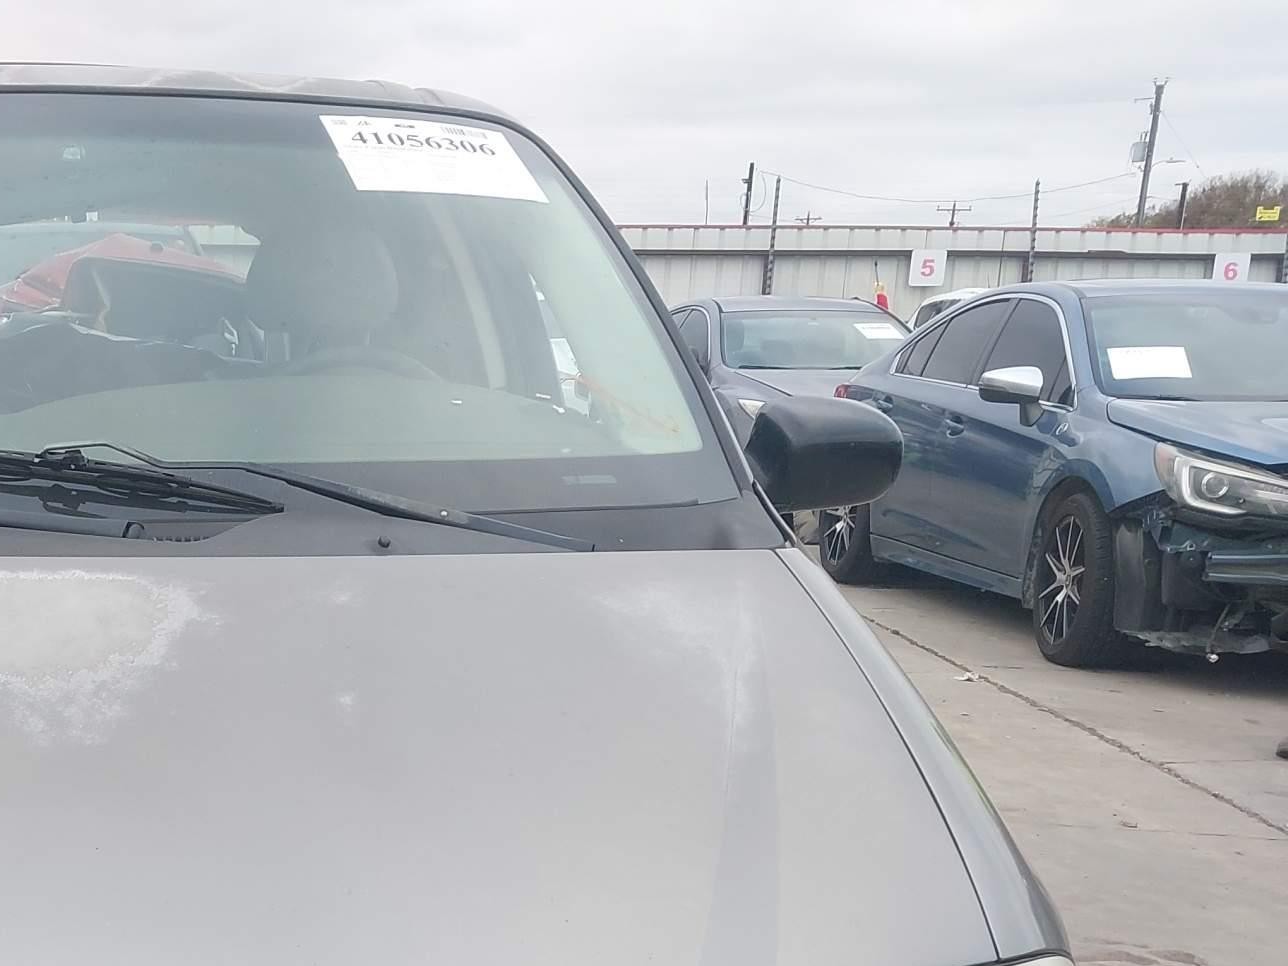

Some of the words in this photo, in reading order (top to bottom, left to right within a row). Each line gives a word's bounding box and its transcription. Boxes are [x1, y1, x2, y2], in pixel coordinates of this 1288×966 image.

[351, 130, 497, 157] 41056306
[920, 258, 936, 277] 5
[1223, 262, 1239, 281] 6
